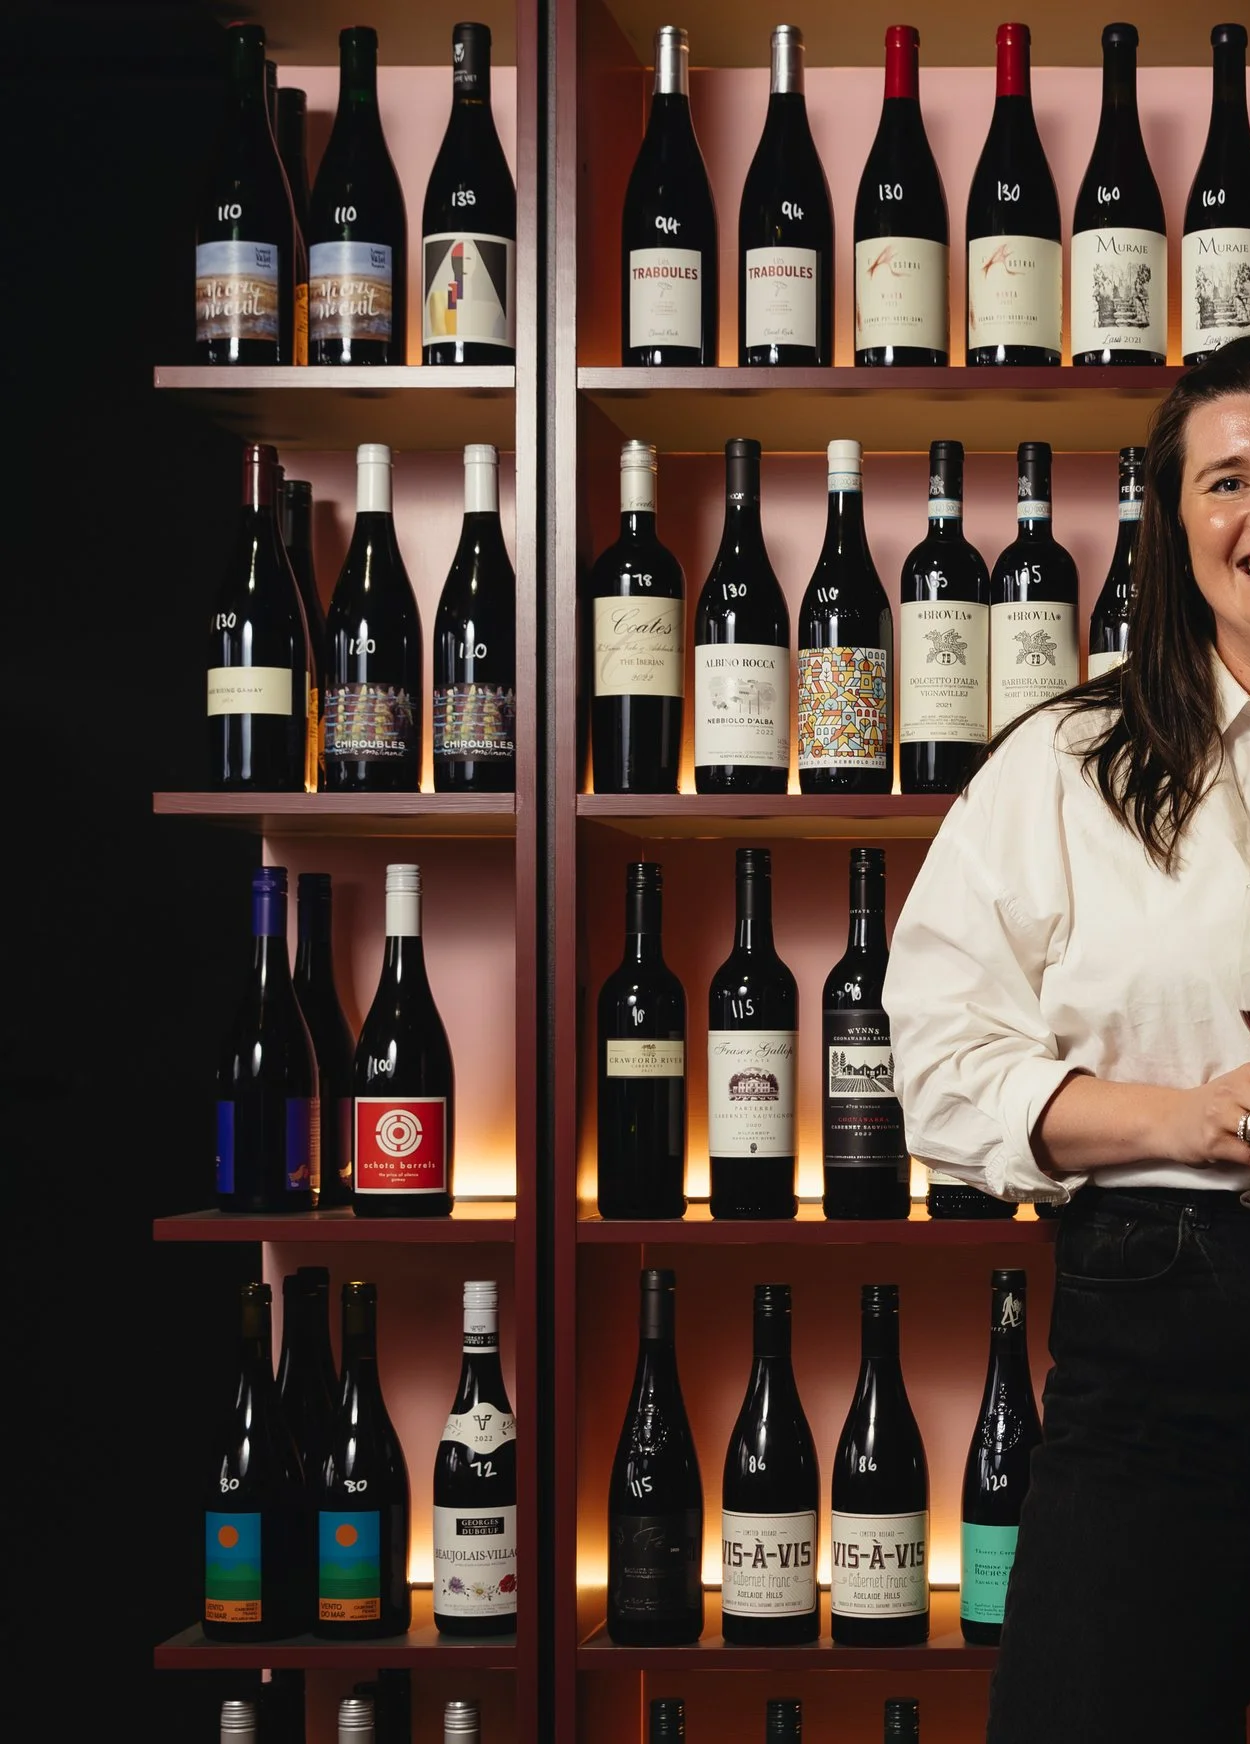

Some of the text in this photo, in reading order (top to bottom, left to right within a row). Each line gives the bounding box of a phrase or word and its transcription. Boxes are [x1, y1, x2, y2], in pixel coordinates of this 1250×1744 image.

[451, 190, 476, 207] 135
[879, 184, 903, 201] 130
[997, 181, 1020, 201] 130
[1097, 186, 1120, 202] 160
[1202, 189, 1225, 206] 160
[218, 204, 242, 221] 110
[335, 206, 357, 224] 110
[781, 201, 804, 220] 94
[655, 215, 681, 235] 94
[632, 266, 698, 280] TRABOULES
[748, 265, 813, 279] TRABOULES
[632, 574, 652, 587] 78
[722, 583, 747, 600] 130
[817, 587, 839, 603] 110
[216, 612, 236, 629] 130
[611, 608, 672, 635] Coates
[923, 610, 967, 620] BROVIA
[1012, 611, 1056, 621] BROVIA
[349, 638, 376, 655] 120
[459, 642, 487, 659] 120
[704, 658, 739, 668] ALBINO
[910, 677, 979, 686] DOLCETTO D'ALBA
[747, 717, 774, 725] D'ALBA
[334, 740, 406, 750] CHIROUBLES
[443, 740, 515, 750] CHIROUBLES
[732, 999, 755, 1018] 115
[848, 1027, 880, 1035] WYNNS
[714, 1041, 793, 1059] Fraser Gallop
[373, 1058, 392, 1074] 100
[364, 1160, 436, 1169] ochota barrels
[470, 1461, 497, 1478] 72
[749, 1455, 766, 1473] 86
[858, 1455, 877, 1473] 86
[220, 1478, 239, 1493] 80
[344, 1479, 367, 1493] 80
[631, 1476, 653, 1498] 115
[985, 1474, 1008, 1491] 120
[833, 1539, 924, 1570] VIS-À-VIS
[733, 1571, 766, 1588] Cabernet
[848, 1572, 884, 1589] Cabernet
[737, 1590, 783, 1599] ADELAIDE HILLS
[853, 1591, 901, 1599] ADELAIDE HILLS
